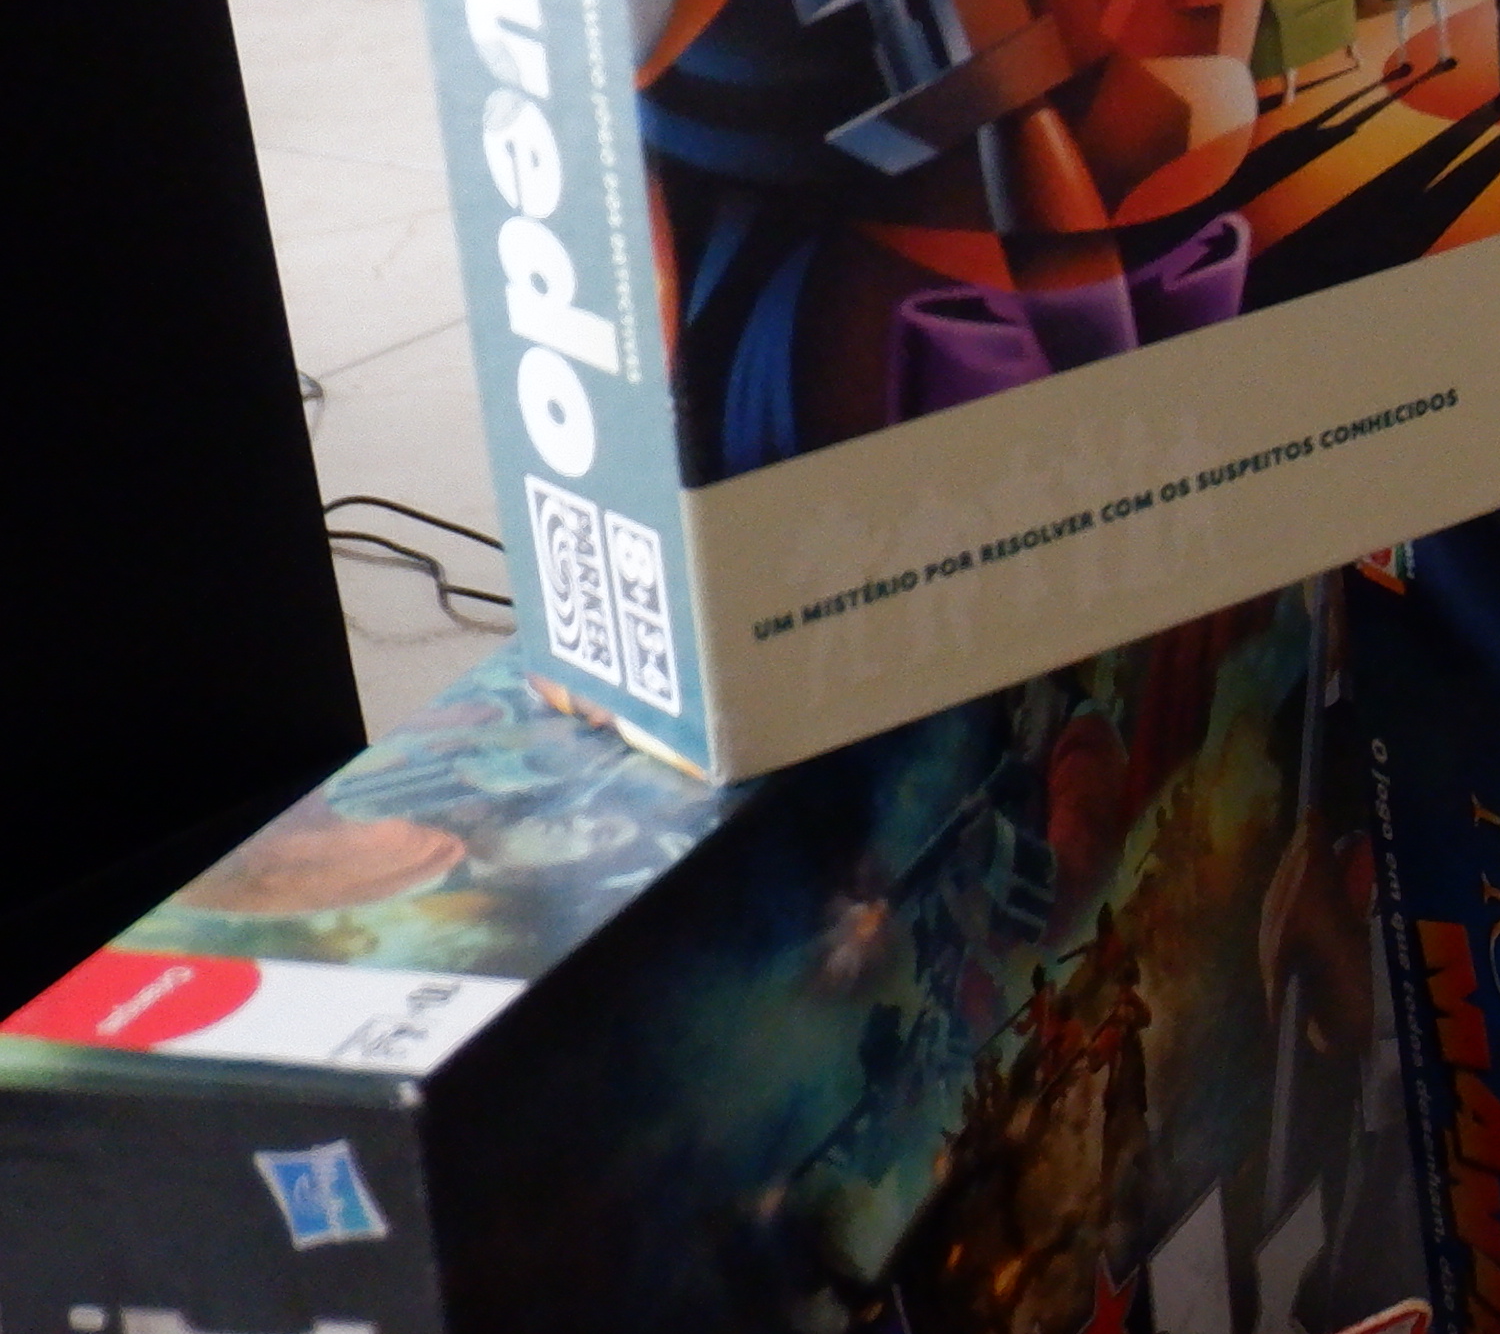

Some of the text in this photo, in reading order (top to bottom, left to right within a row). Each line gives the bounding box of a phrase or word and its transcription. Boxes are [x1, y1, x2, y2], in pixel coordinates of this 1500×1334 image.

[752, 387, 1459, 643] UM MISTÉRIO POR RESOLVER COM OS SUSPEITOS CONHECIDOS
